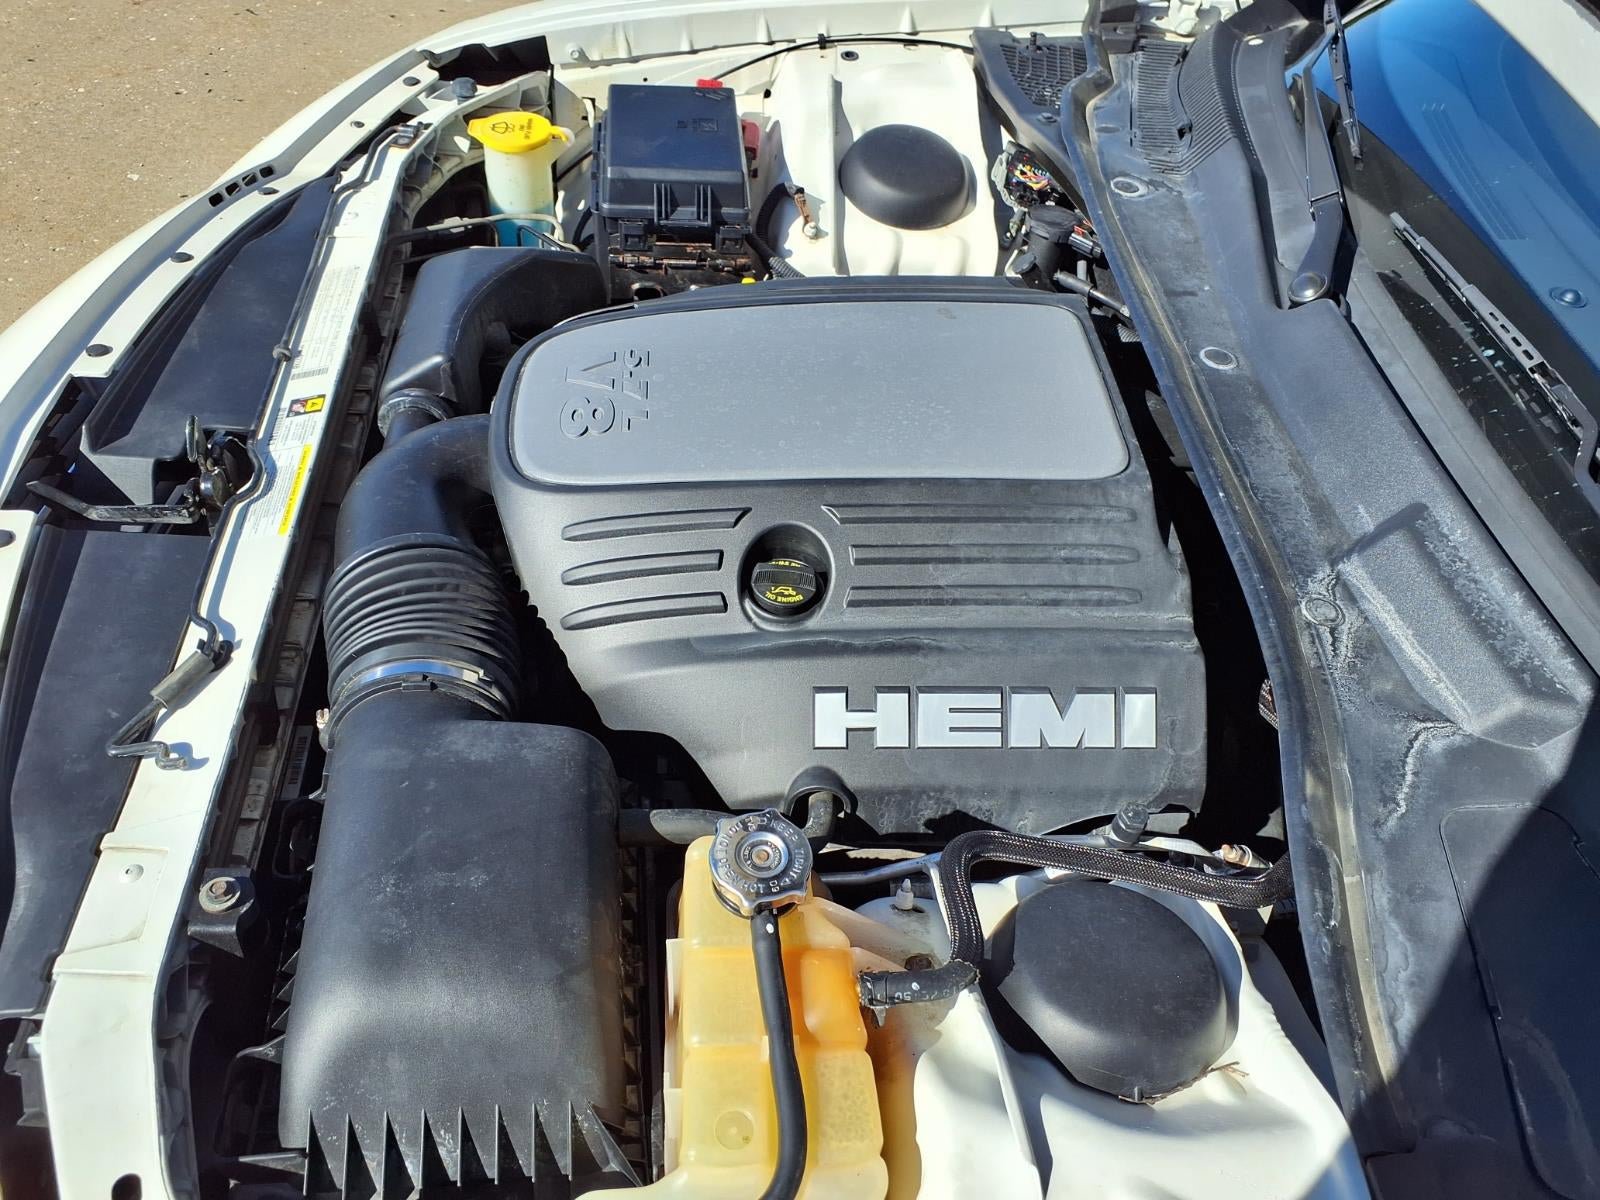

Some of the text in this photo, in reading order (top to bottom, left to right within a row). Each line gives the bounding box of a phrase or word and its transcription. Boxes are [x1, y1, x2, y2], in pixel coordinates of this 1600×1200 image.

[559, 351, 617, 440] V8
[621, 349, 649, 433] 5.7L
[765, 591, 804, 603] ENGINE OIL
[812, 685, 1158, 749] HEMI
[770, 819, 798, 841] KEEP
[790, 847, 805, 880] TIGHT
[740, 881, 766, 894] HOT
